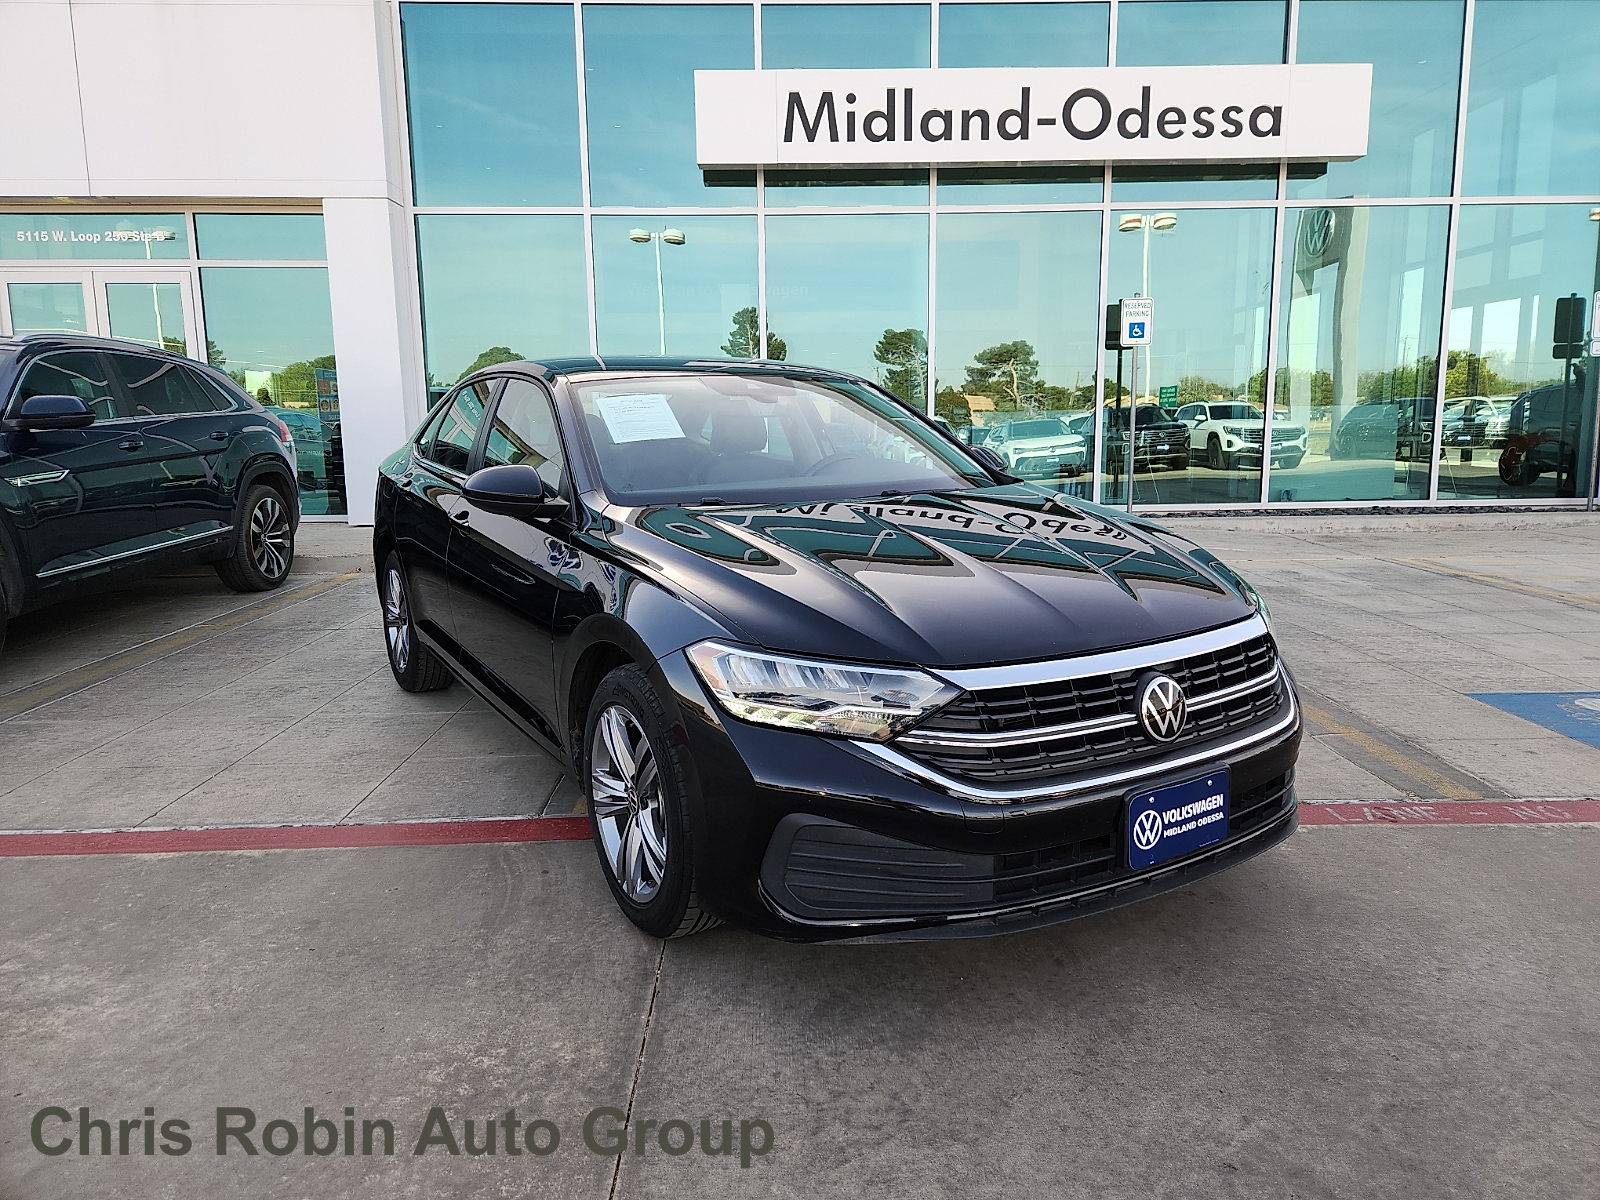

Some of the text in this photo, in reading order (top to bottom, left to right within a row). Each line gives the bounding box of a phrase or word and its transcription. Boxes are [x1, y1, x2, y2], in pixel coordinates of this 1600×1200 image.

[784, 86, 1284, 143] Midland-Odessa
[16, 231, 48, 242] 5115
[52, 231, 67, 242] W.
[71, 231, 101, 243] Loop
[1162, 793, 1224, 825] VOLKSWAGEN
[1163, 811, 1224, 838] MIDLAND ODESSA
